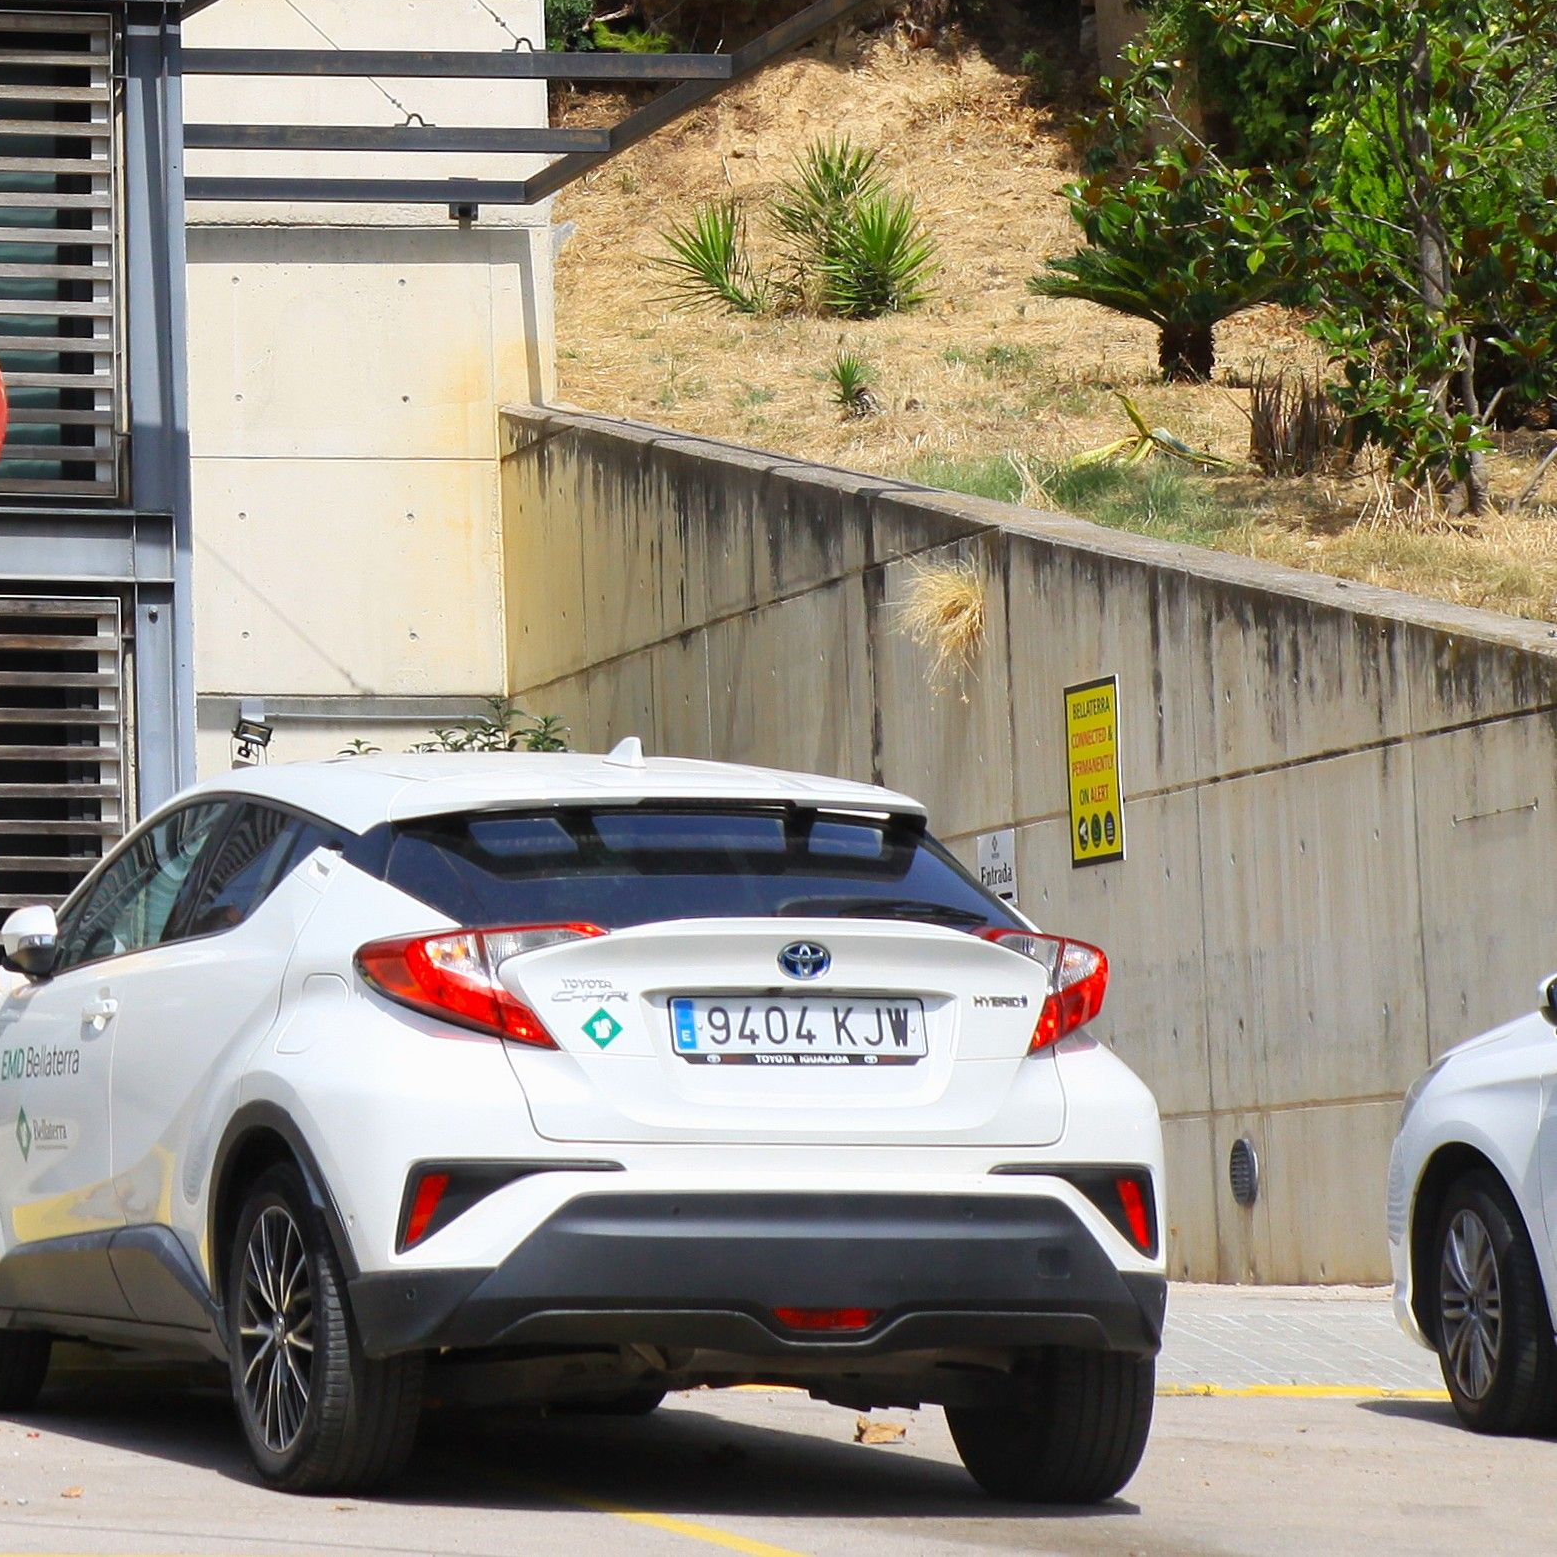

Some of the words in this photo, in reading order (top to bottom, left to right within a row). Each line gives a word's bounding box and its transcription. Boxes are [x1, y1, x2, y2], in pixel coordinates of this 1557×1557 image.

[1072, 696, 1111, 720] BELLATERRA
[981, 862, 1013, 886] Entrada
[561, 979, 613, 989] TOYOTA
[682, 1030, 692, 1042] E
[707, 1006, 817, 1046] 9404
[832, 1006, 909, 1047] KJW
[1, 1048, 25, 1080] EMD
[25, 1045, 80, 1078] Bellaterra
[755, 1054, 795, 1064] TOYOTA
[33, 1119, 68, 1141] Bellaterra
